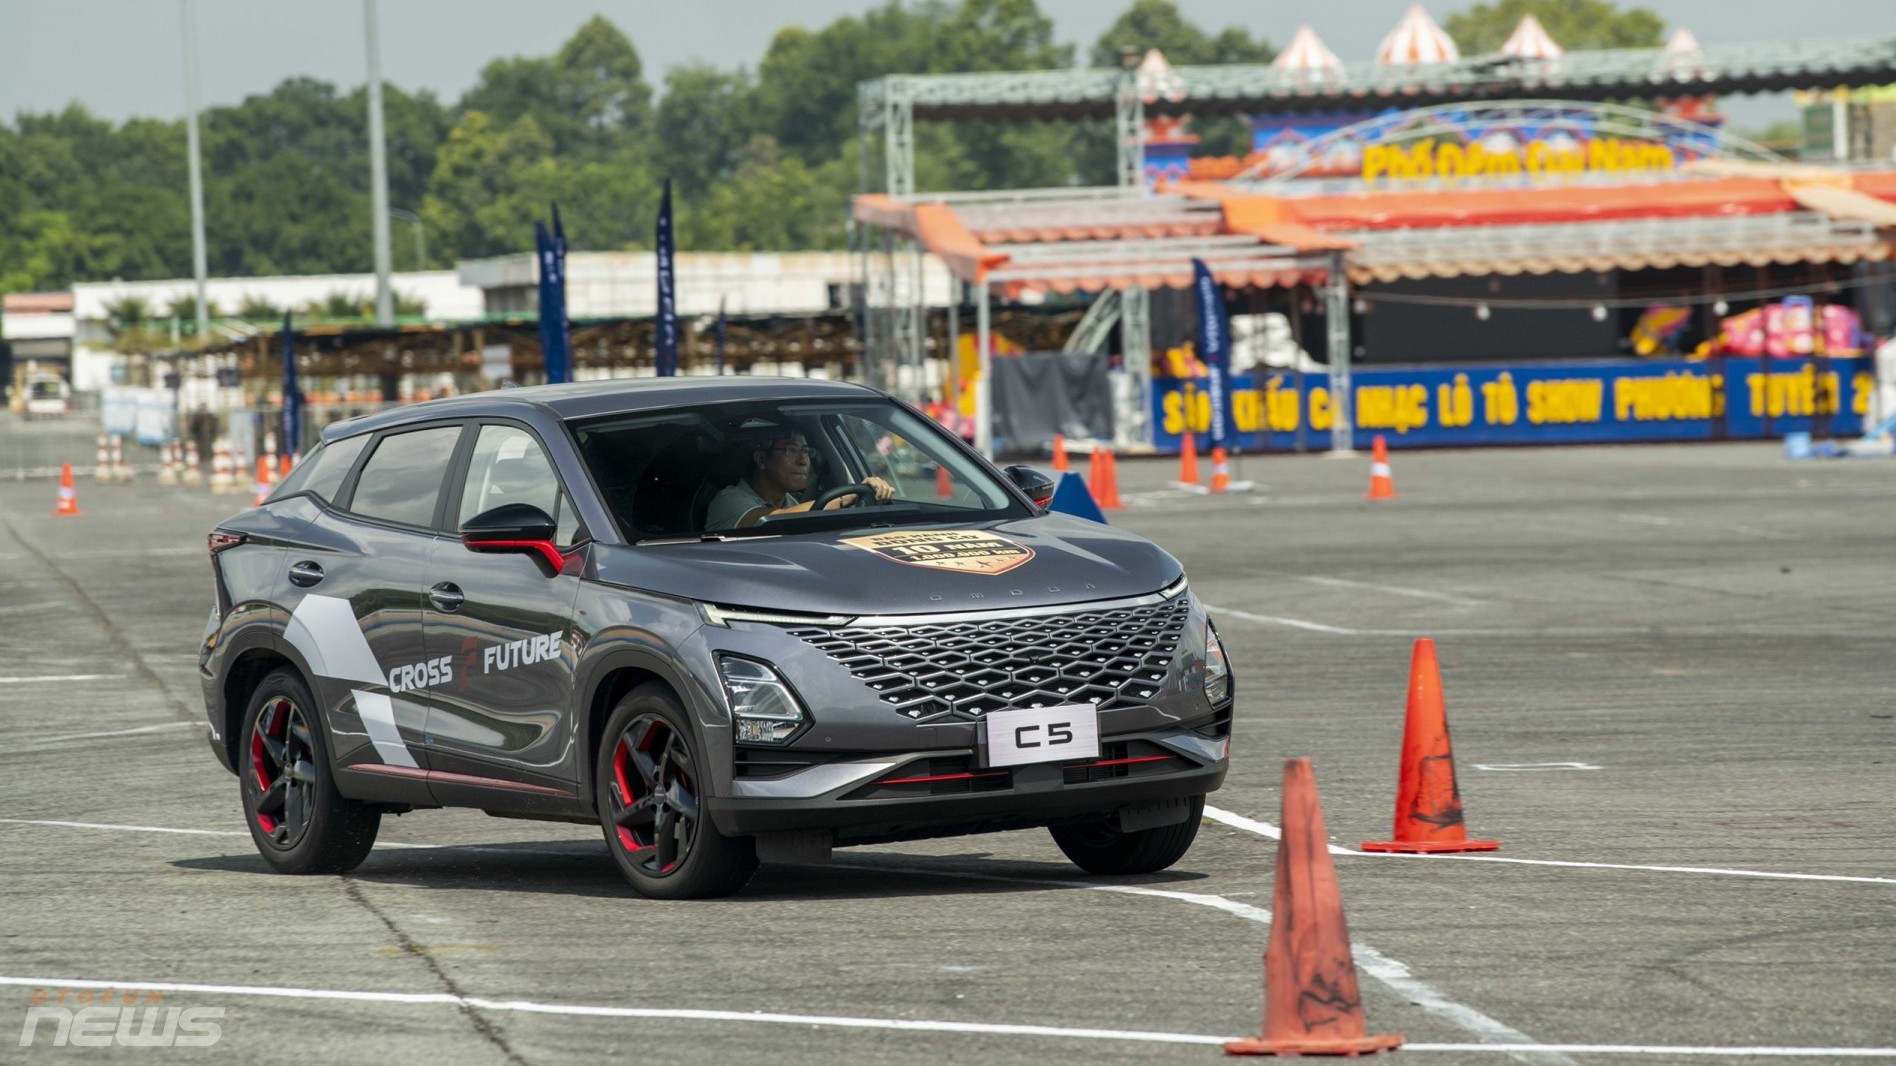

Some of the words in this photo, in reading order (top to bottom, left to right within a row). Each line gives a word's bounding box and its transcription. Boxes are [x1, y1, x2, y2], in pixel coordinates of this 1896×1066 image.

[1590, 136, 1674, 173] Nam
[1438, 373, 1473, 427] LÔ
[1482, 371, 1518, 426] TÔ
[1527, 377, 1603, 424] SHOW
[891, 544, 941, 555] 10
[389, 655, 453, 693] CROSS
[483, 630, 563, 674] FUTURE
